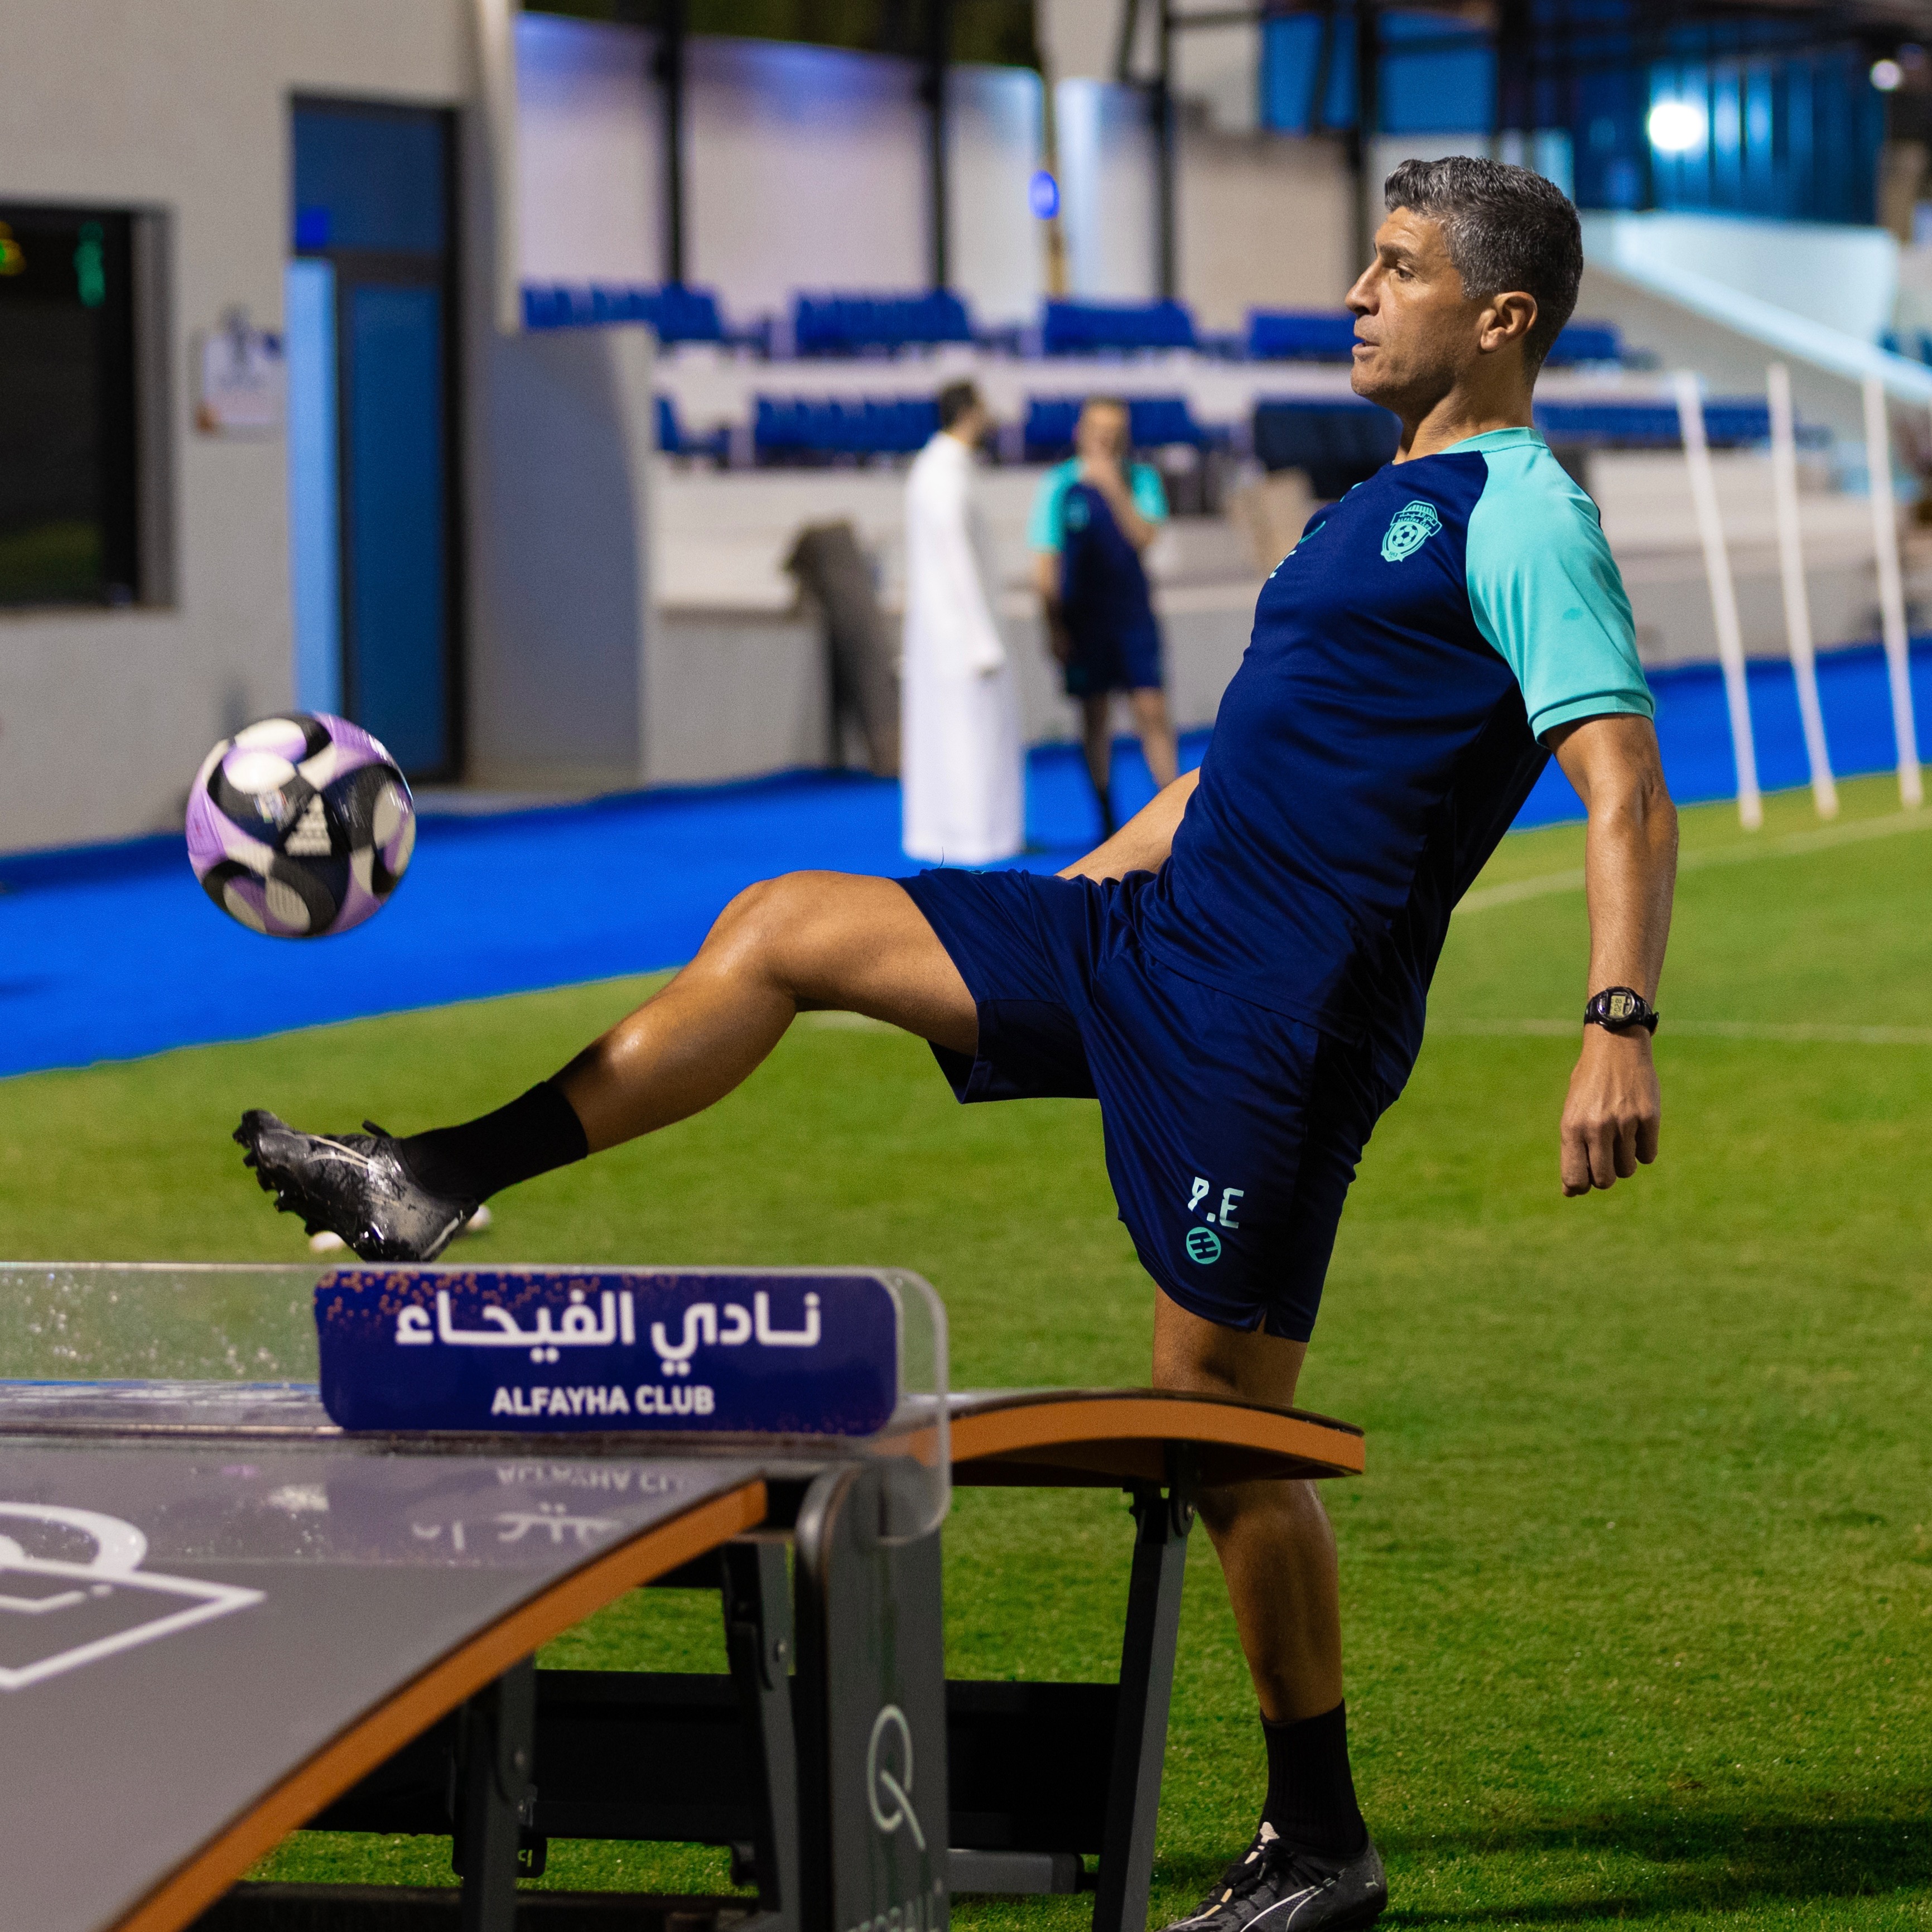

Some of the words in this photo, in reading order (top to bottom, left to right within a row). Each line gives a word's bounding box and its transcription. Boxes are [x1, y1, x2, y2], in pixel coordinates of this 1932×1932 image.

[1420, 521, 1432, 530] CLUB
[394, 1289, 635, 1364] الفيحاء
[651, 1290, 821, 1376] نادي
[491, 1385, 630, 1416] ALFAYHA
[635, 1385, 715, 1415] CLUB
